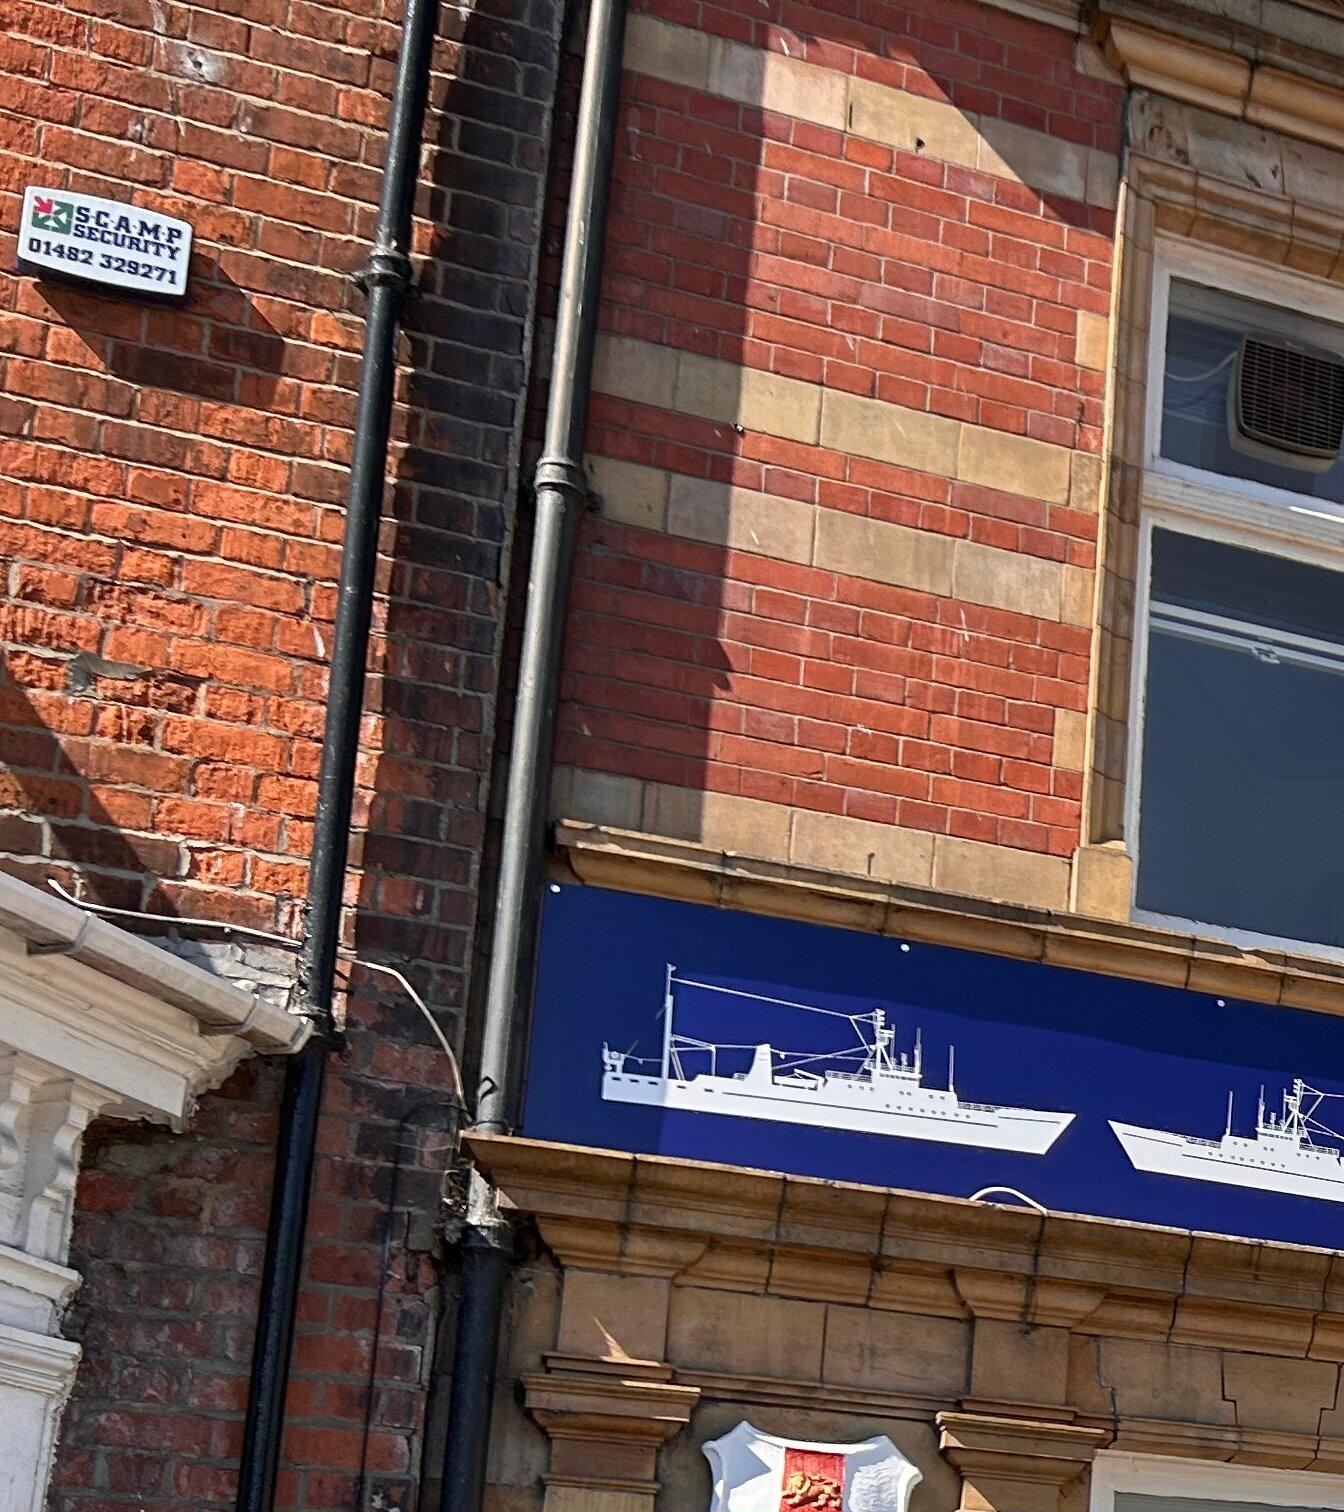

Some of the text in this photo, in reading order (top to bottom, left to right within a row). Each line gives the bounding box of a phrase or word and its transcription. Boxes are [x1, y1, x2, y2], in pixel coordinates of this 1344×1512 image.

[28, 237, 177, 285] 01482 329271
[73, 224, 181, 260] SECURITY
